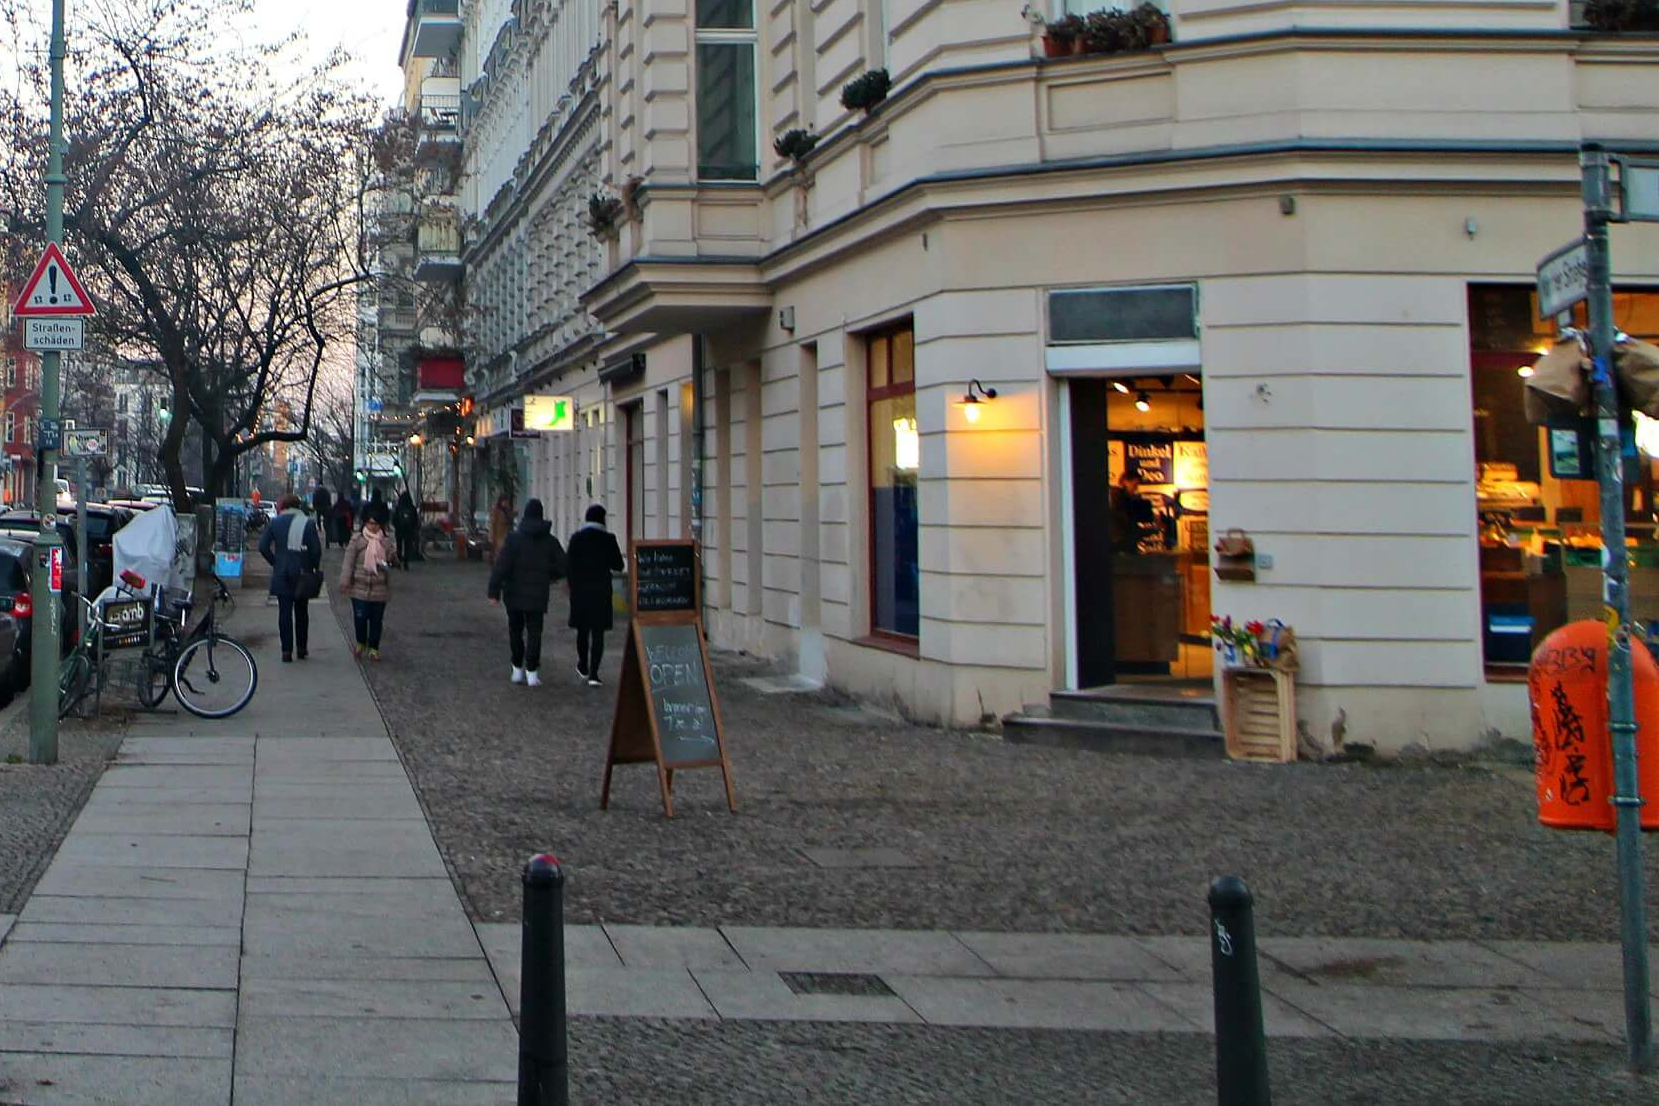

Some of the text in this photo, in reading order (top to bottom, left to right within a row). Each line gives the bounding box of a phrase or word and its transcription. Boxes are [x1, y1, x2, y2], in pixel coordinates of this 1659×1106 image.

[32, 322, 75, 333] Straßen-
[33, 334, 75, 345] schäden
[1127, 444, 1173, 458] Dinkel
[650, 662, 698, 686] OPEN
